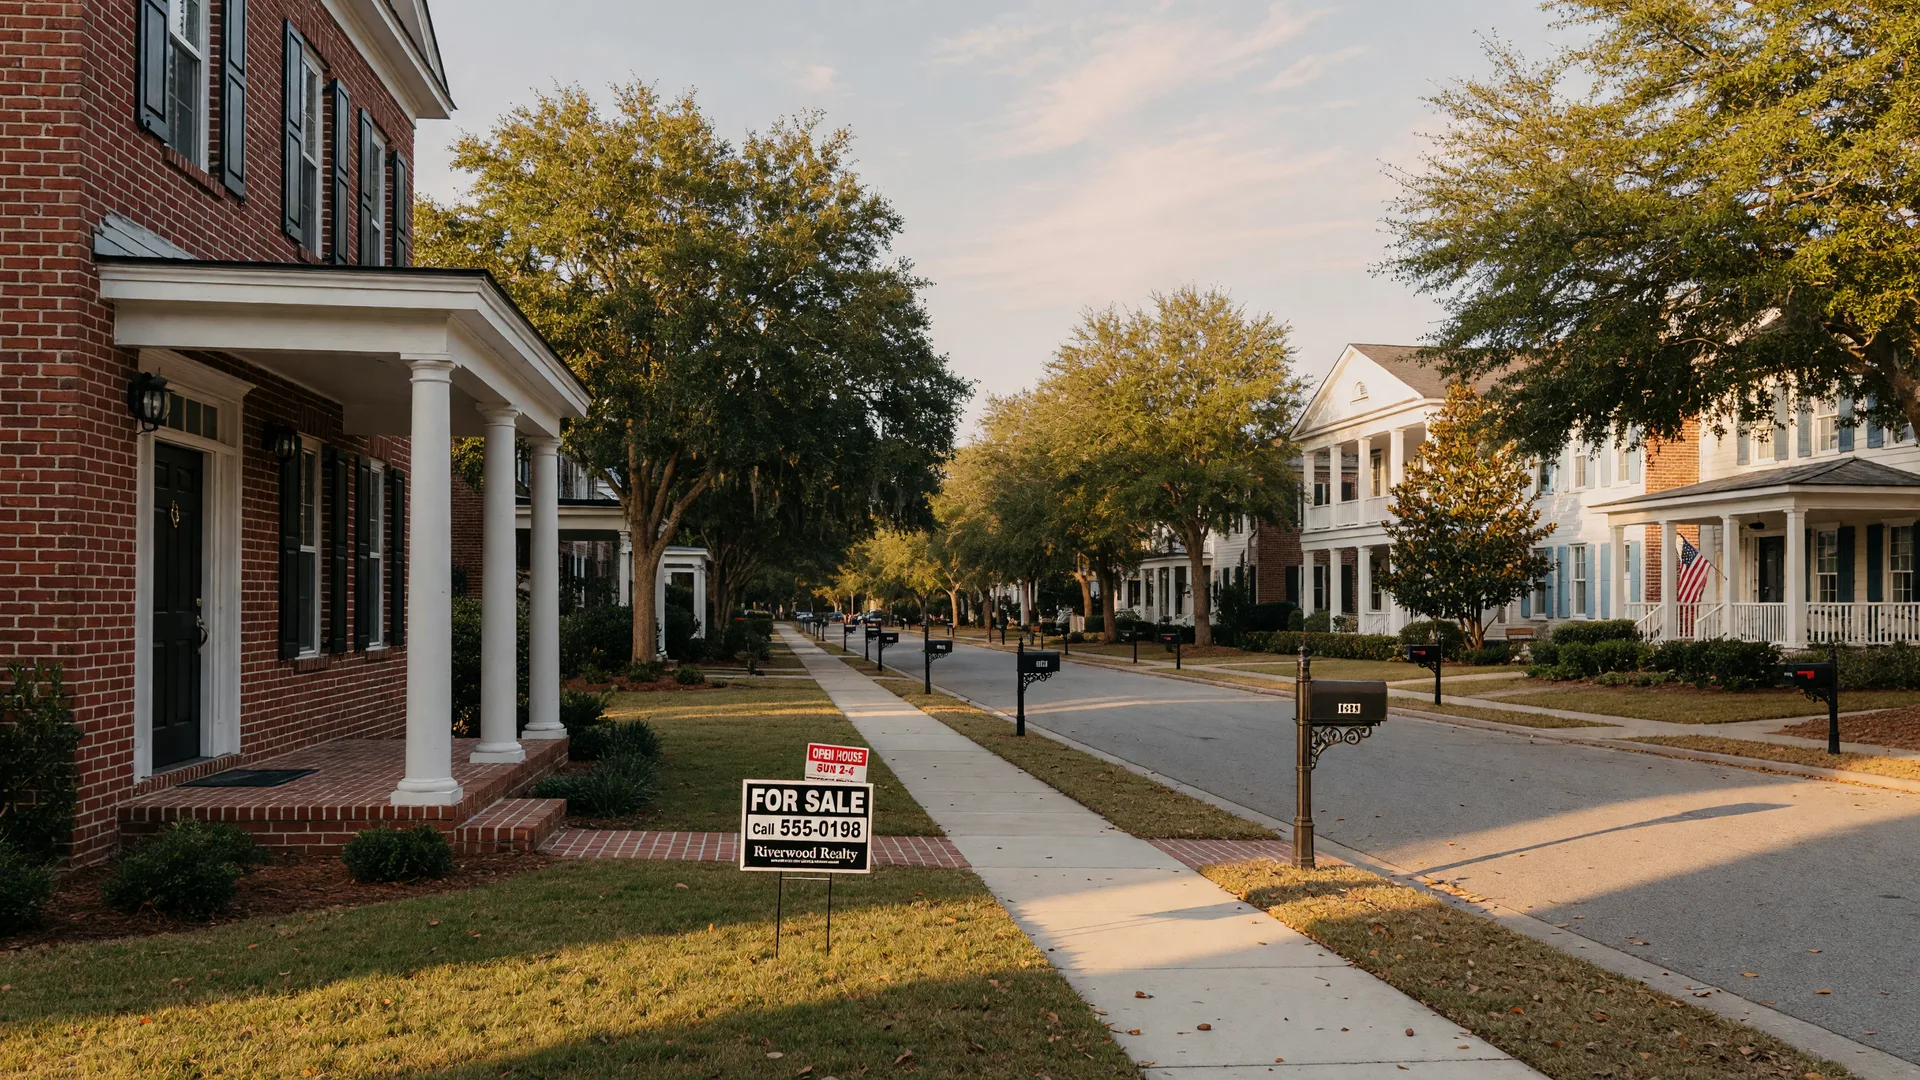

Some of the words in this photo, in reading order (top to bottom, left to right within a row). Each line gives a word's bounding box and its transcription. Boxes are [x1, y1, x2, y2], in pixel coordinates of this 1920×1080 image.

[836, 750, 863, 763] HOUSE
[817, 763, 836, 774] SUN
[839, 765, 854, 776] 2-4
[751, 788, 798, 812] FOR
[804, 789, 865, 814] SALE
[753, 822, 774, 835] Call
[780, 819, 861, 838] 555-0198
[754, 845, 817, 859] Riverwood
[821, 847, 858, 863] Realty
